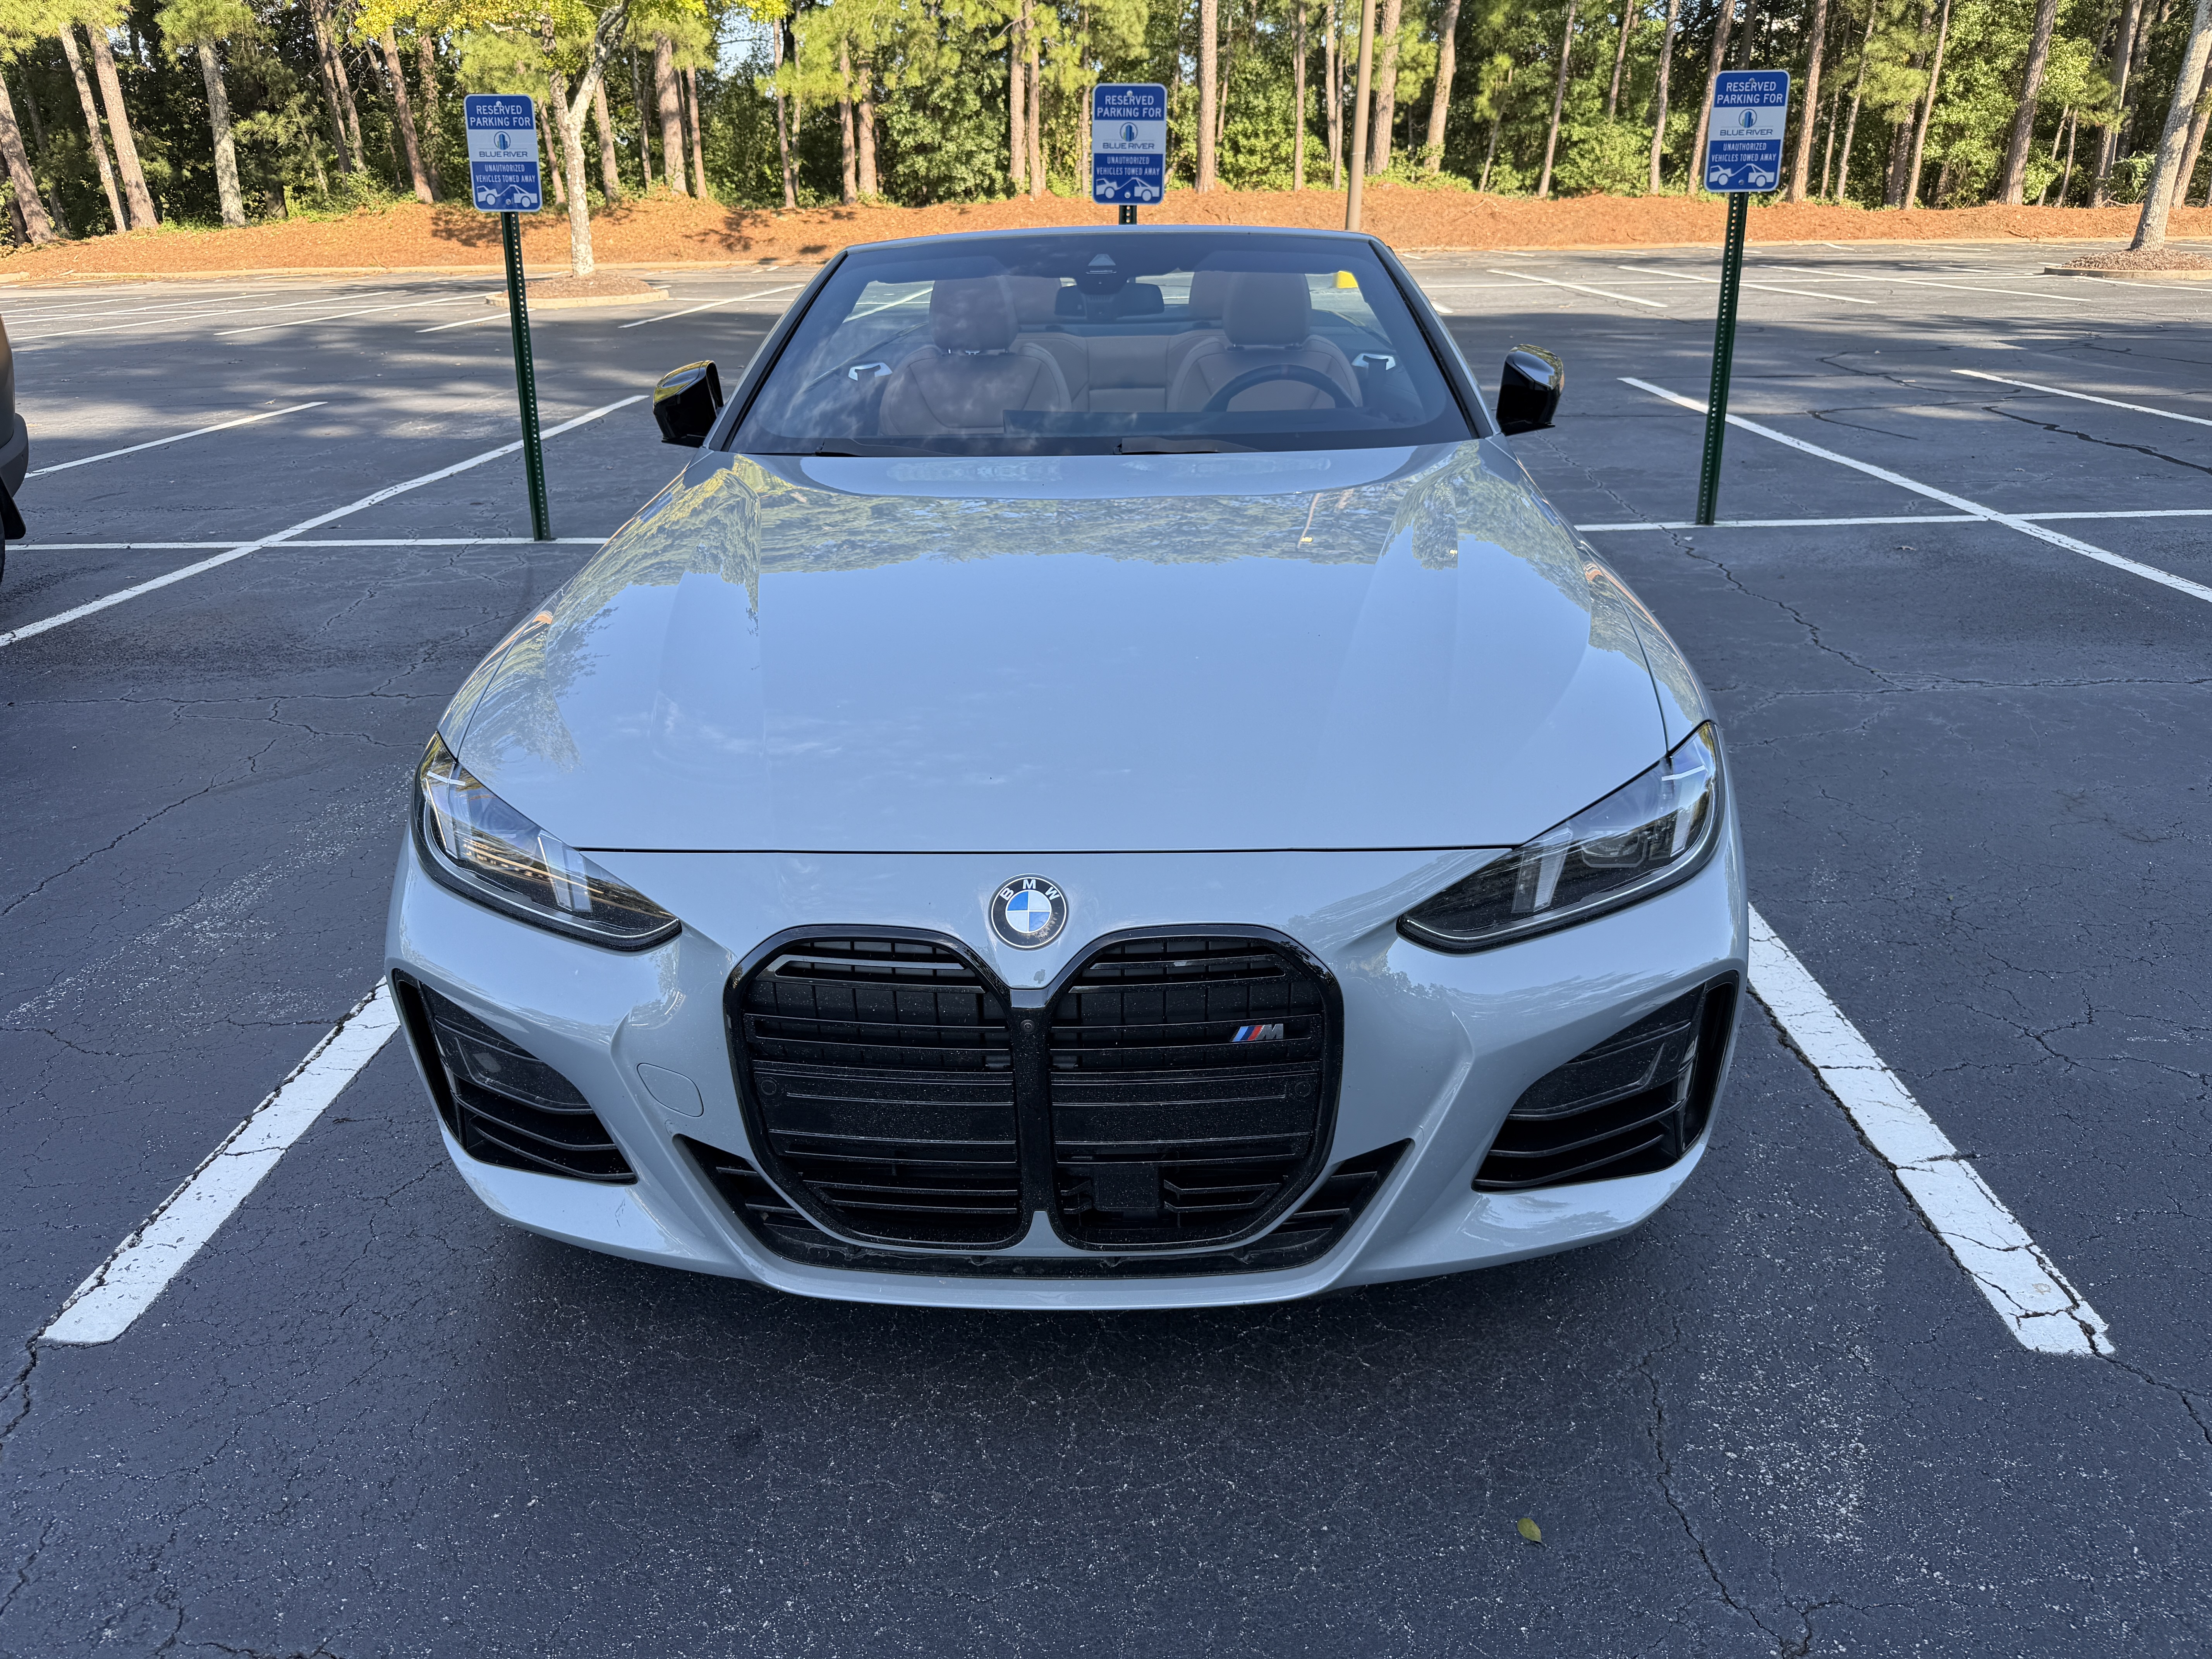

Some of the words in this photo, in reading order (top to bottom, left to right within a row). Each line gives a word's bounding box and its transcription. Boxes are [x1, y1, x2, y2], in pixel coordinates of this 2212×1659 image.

[1726, 82, 1776, 92] RESERVED
[1105, 96, 1154, 105] RESERVED
[1717, 94, 1759, 104] PARKING
[1764, 93, 1783, 103] FOR
[476, 105, 522, 115] RESERVED
[1097, 107, 1139, 117] PARKING
[1142, 107, 1162, 118] FOR
[470, 117, 510, 126] PARKING
[513, 117, 531, 126] FOR
[1723, 143, 1766, 151] UNAUTHORIZED
[1000, 879, 1060, 901] BMW
